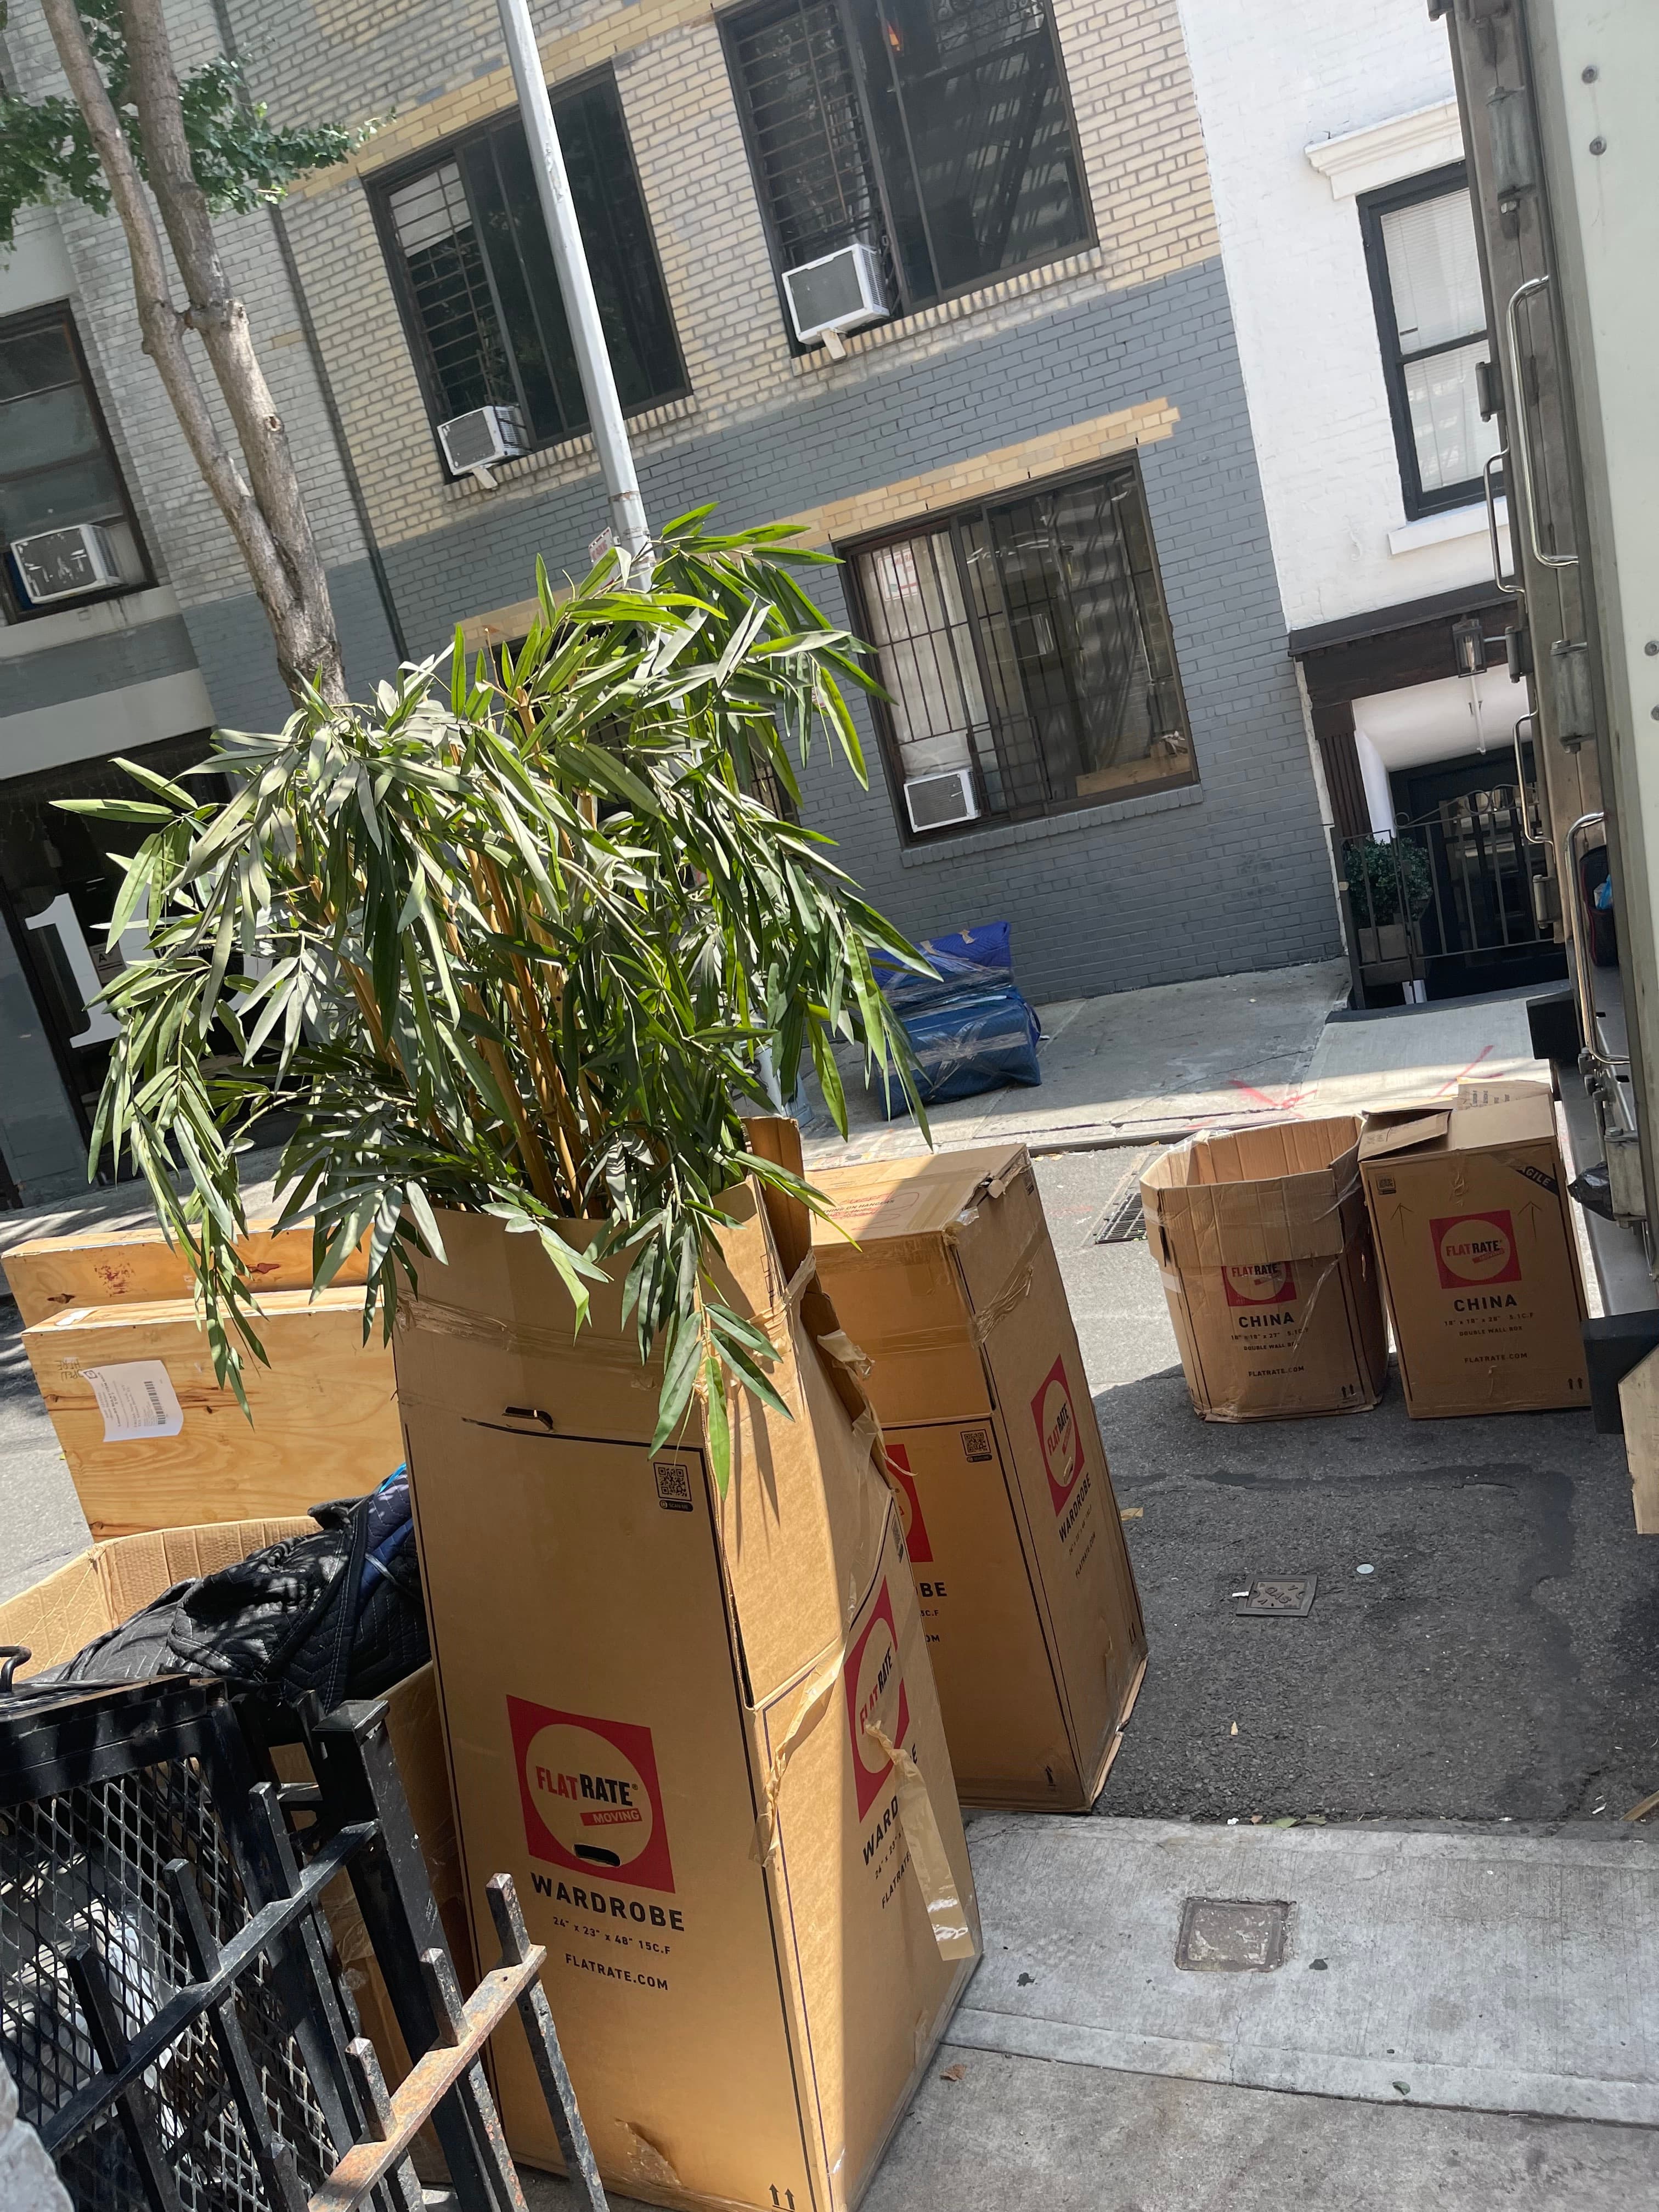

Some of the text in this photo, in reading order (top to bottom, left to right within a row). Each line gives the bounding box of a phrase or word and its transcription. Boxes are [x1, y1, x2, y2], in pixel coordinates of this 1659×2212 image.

[1520, 1166, 1549, 1186] AGILE
[1446, 1240, 1499, 1256] FLATRATE
[1231, 1264, 1278, 1277] FLATRATE
[1453, 1294, 1518, 1312] CHINA
[1239, 1312, 1295, 1328] CHINA
[1464, 1352, 1528, 1364] FLATRATE.COM
[1248, 1365, 1304, 1378] FLATRATE.COM
[1058, 1471, 1091, 1543] WARDROBE
[535, 1765, 633, 1807] FLATRATE
[593, 1810, 640, 1825] MOVING
[530, 1872, 685, 1932] WARDROBE
[552, 1916, 569, 1927] 24"
[583, 1926, 600, 1937] 23"
[614, 1936, 633, 1945] 48"
[639, 1940, 671, 1955] 15C.F
[565, 1953, 669, 1991] FLATRATE.COM
